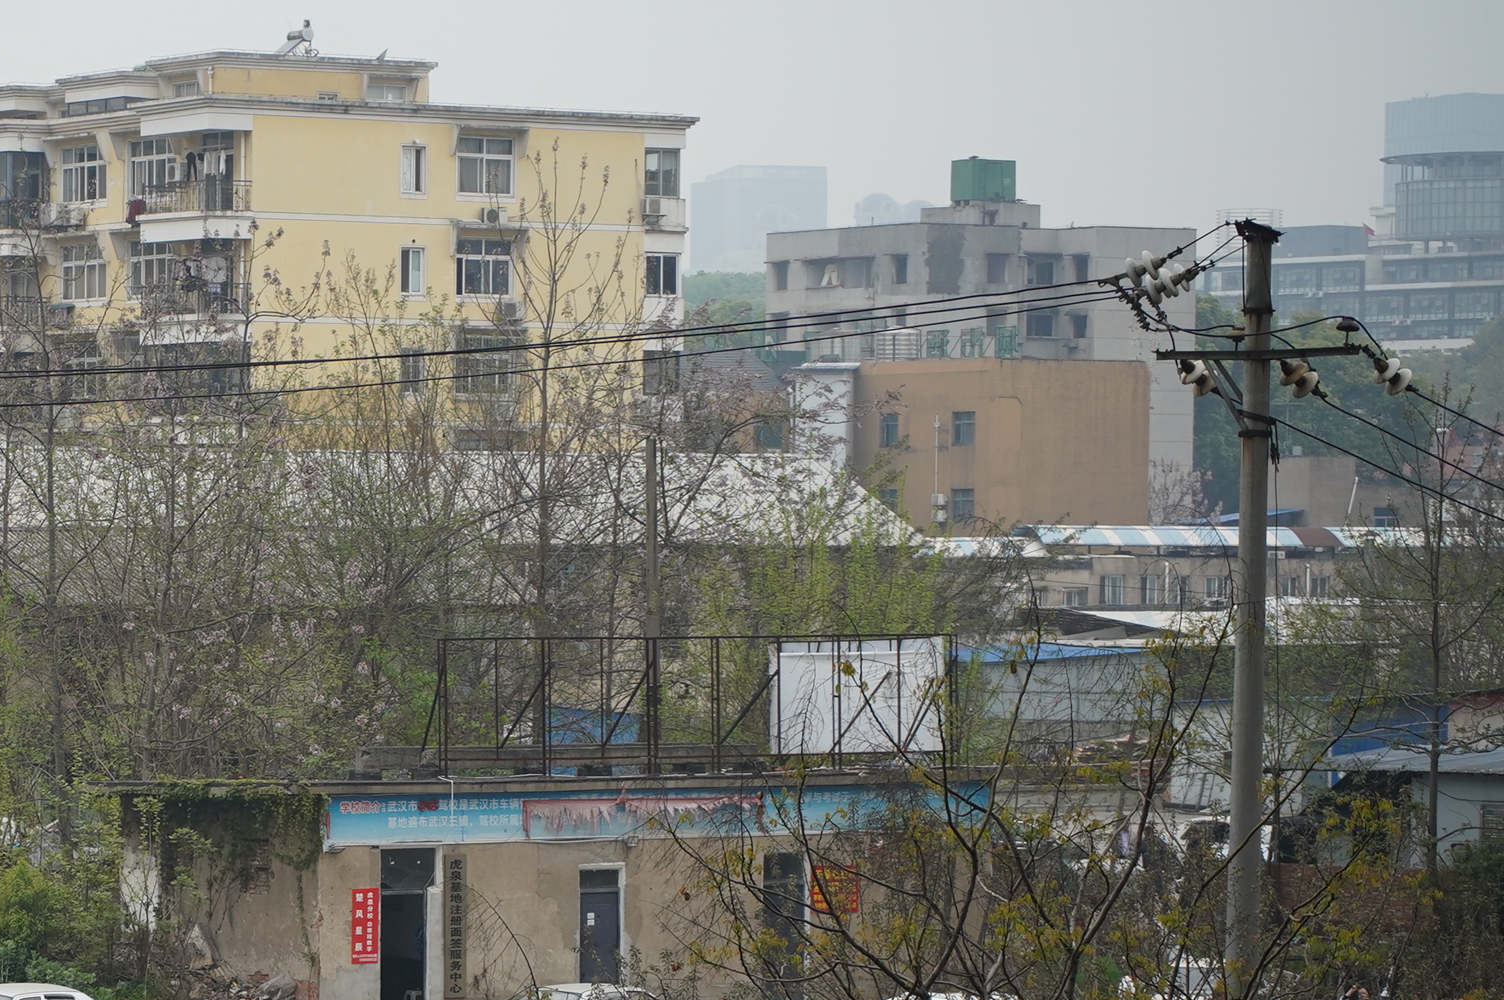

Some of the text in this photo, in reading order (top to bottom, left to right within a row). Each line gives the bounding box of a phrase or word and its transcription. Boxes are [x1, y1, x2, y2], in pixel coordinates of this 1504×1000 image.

[354, 893, 364, 952] 楚风星辰
[449, 859, 463, 993] 虎泉基地注册面签服务中心
